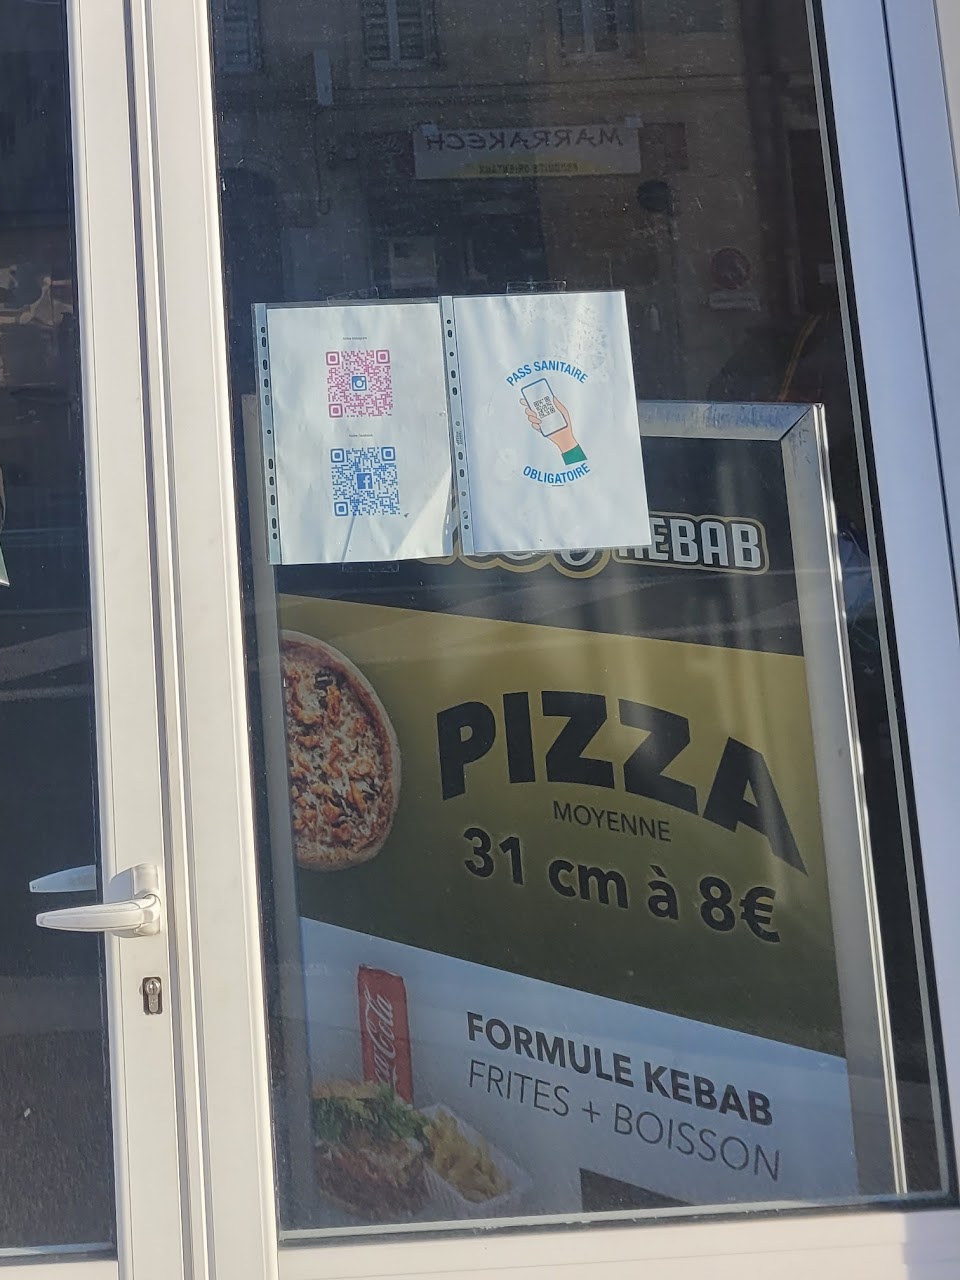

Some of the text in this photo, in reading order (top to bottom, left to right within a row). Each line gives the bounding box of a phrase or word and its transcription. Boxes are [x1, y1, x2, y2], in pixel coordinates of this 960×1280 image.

[506, 360, 588, 386] PASS SANITAIRE
[523, 463, 590, 484] OBLIGATOIRE
[436, 691, 809, 877] PIZZA
[553, 800, 672, 842] MOYENNE
[462, 827, 781, 944] 31 cm à 8€
[467, 1011, 773, 1126] FORMULE KEBAB
[468, 1059, 570, 1117] FRITES
[614, 1103, 780, 1182] BOISSON
